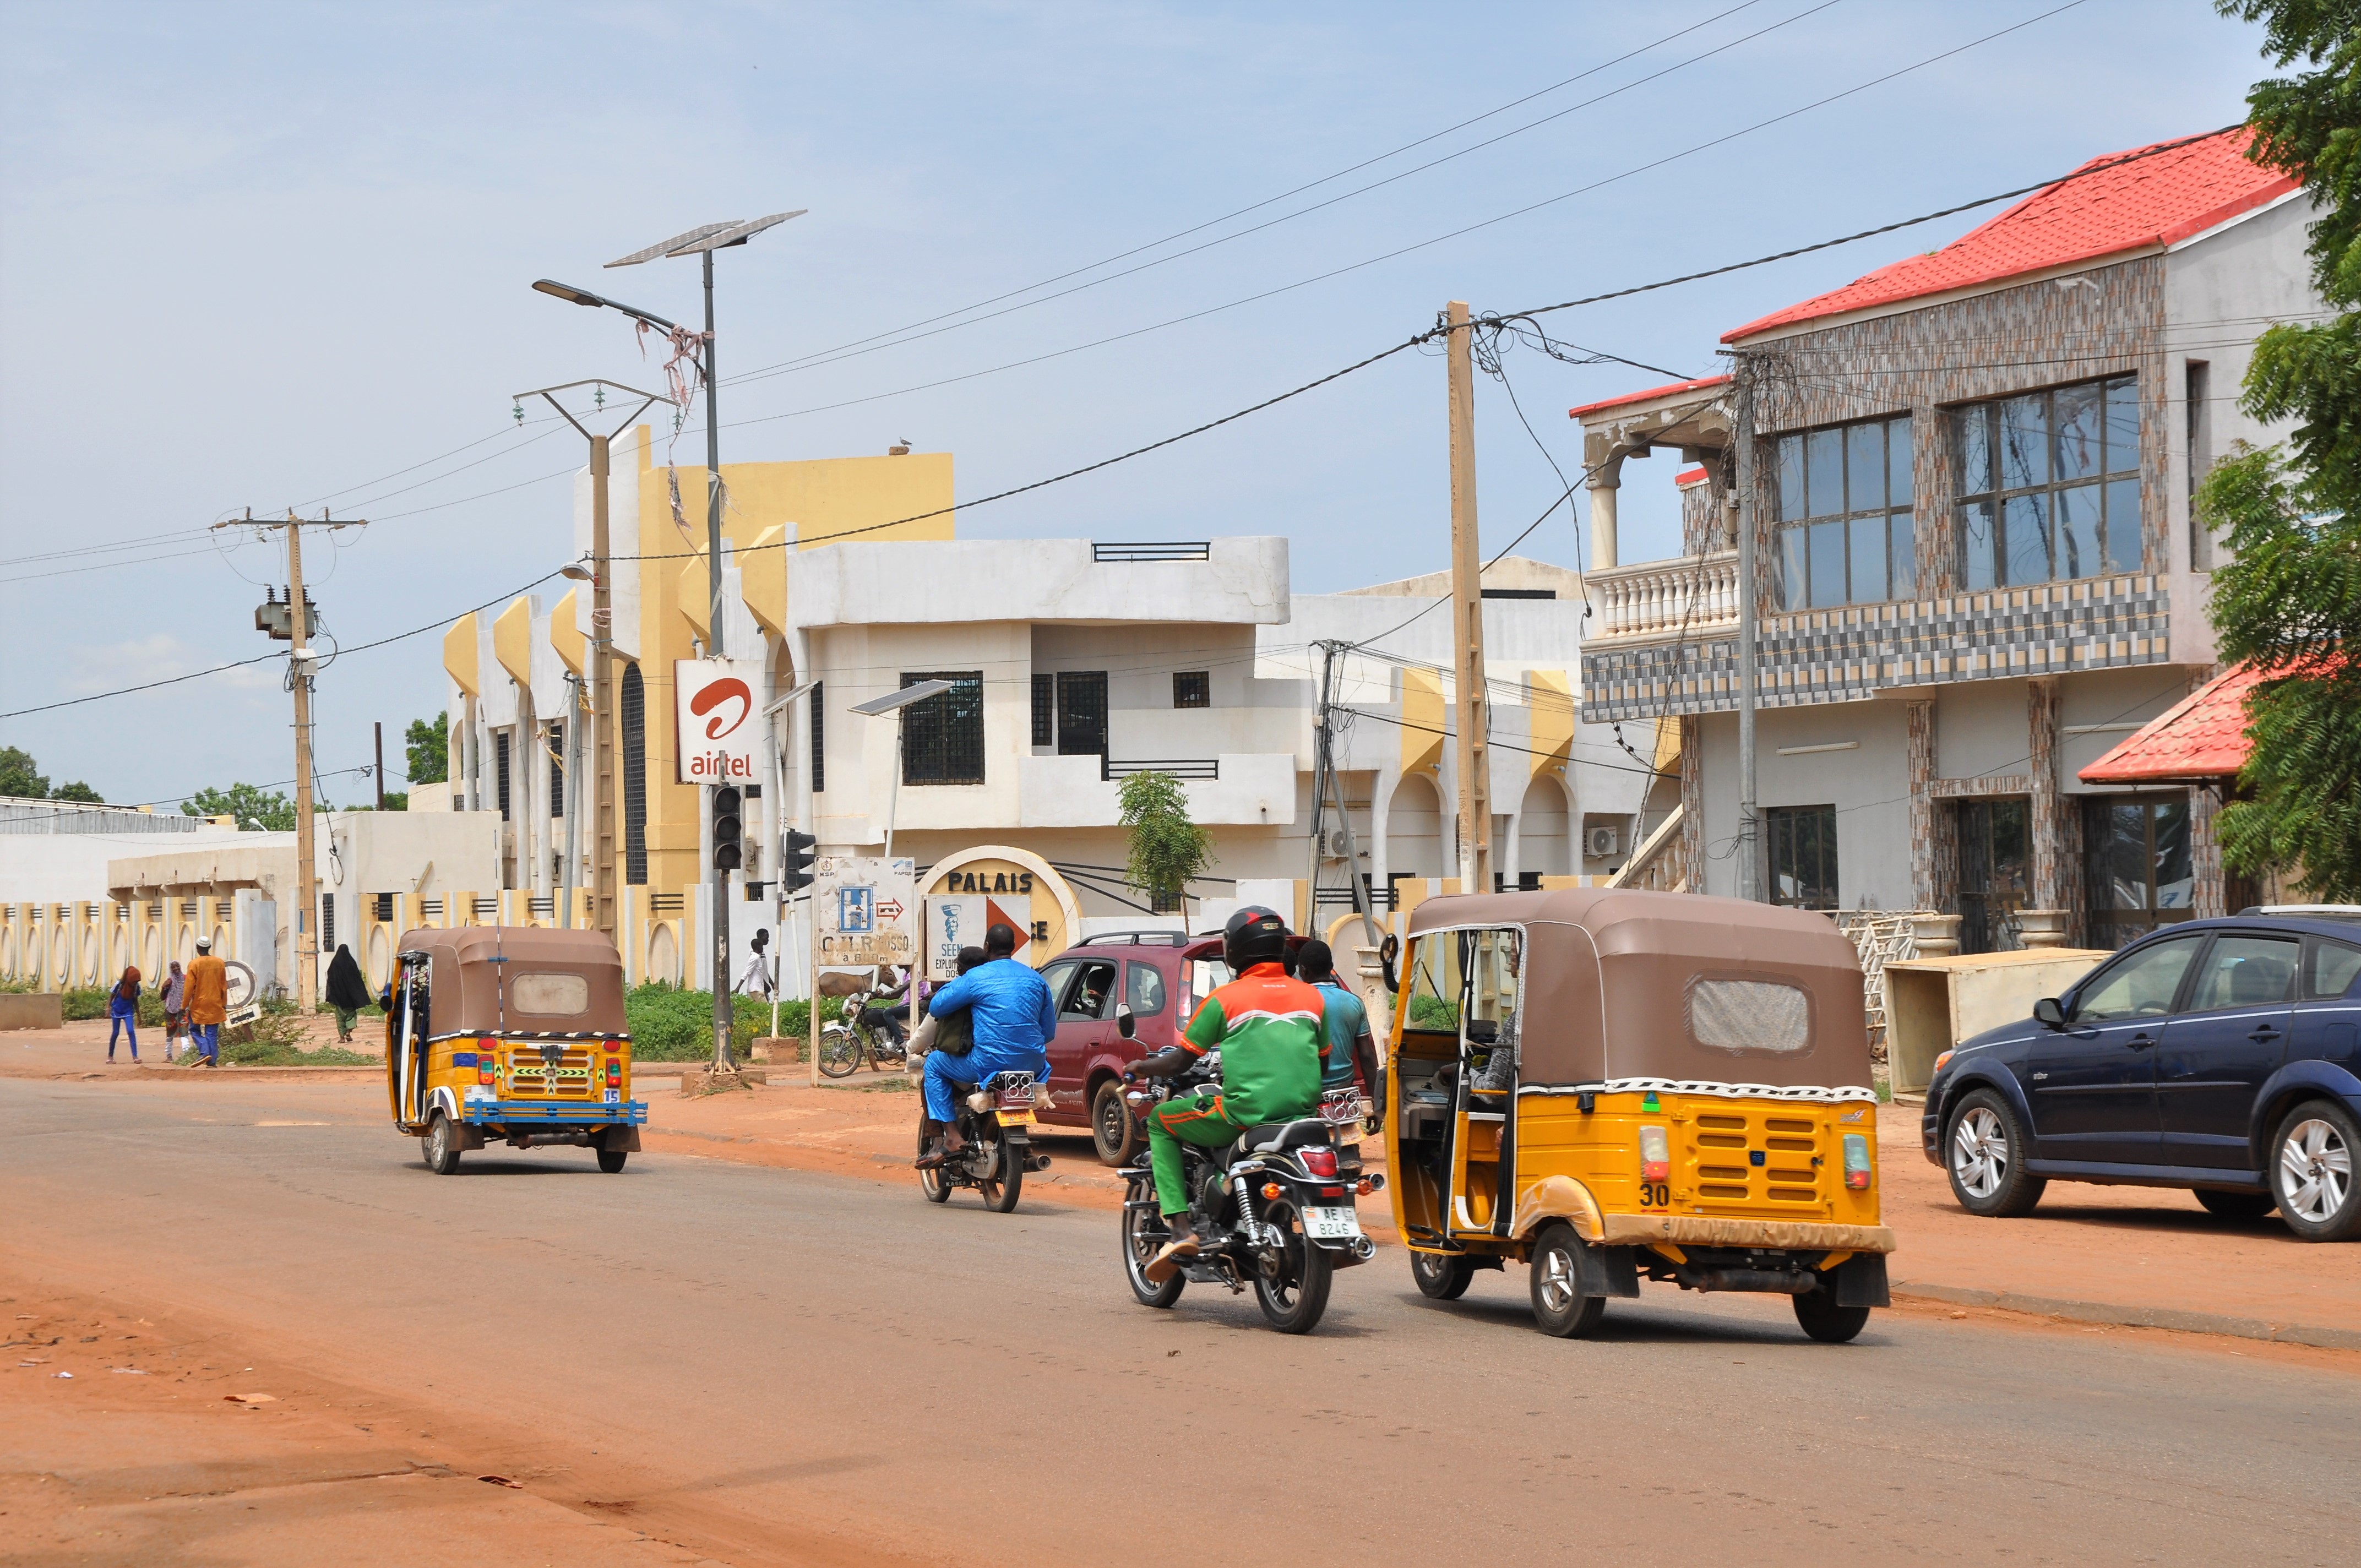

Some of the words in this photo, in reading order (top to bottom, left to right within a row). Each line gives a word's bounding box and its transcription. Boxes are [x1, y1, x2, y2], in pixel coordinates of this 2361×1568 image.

[690, 750, 752, 777] airtel
[948, 872, 1032, 892] PALAIS
[605, 1090, 618, 1102] 15
[1639, 1183, 1669, 1207] 30
[1323, 1208, 1339, 1221] AE
[1319, 1223, 1350, 1235] 8246
